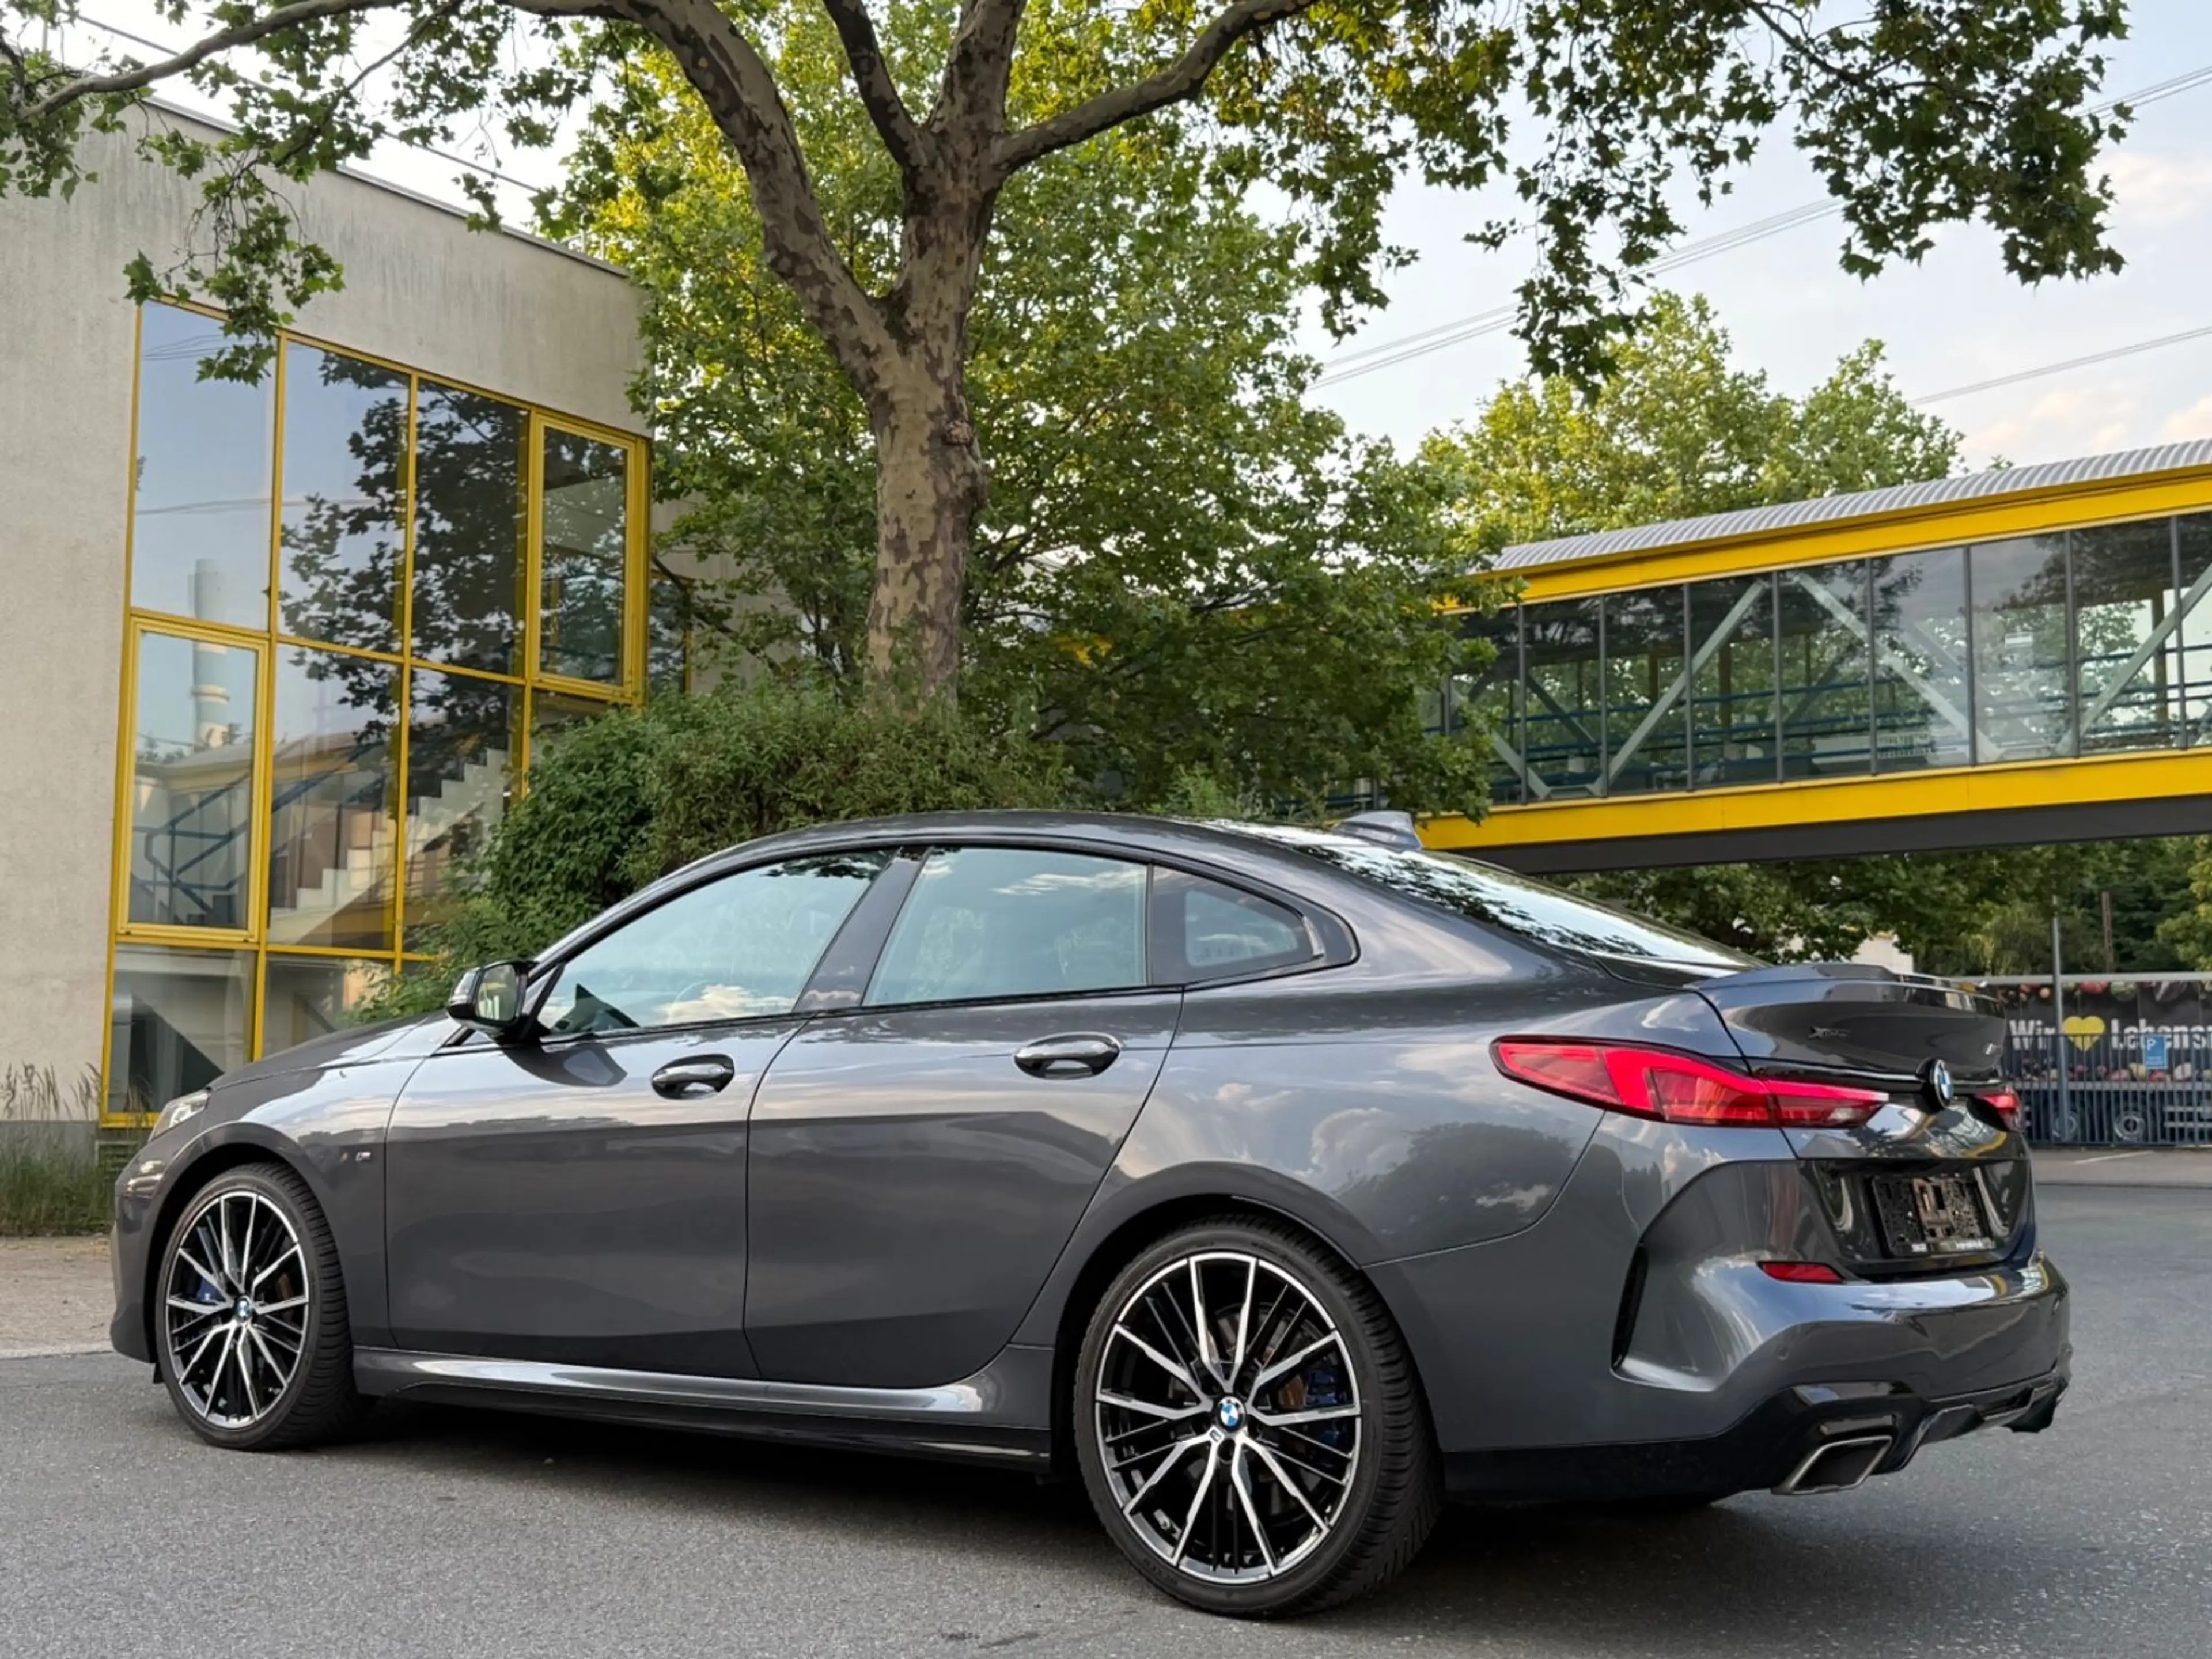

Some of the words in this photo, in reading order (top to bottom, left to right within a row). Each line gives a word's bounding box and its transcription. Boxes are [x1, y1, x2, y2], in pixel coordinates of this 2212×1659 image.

[2009, 1019, 2056, 1050] Wir
[2111, 1018, 2212, 1050] Lebens
[2147, 1039, 2156, 1051] P
